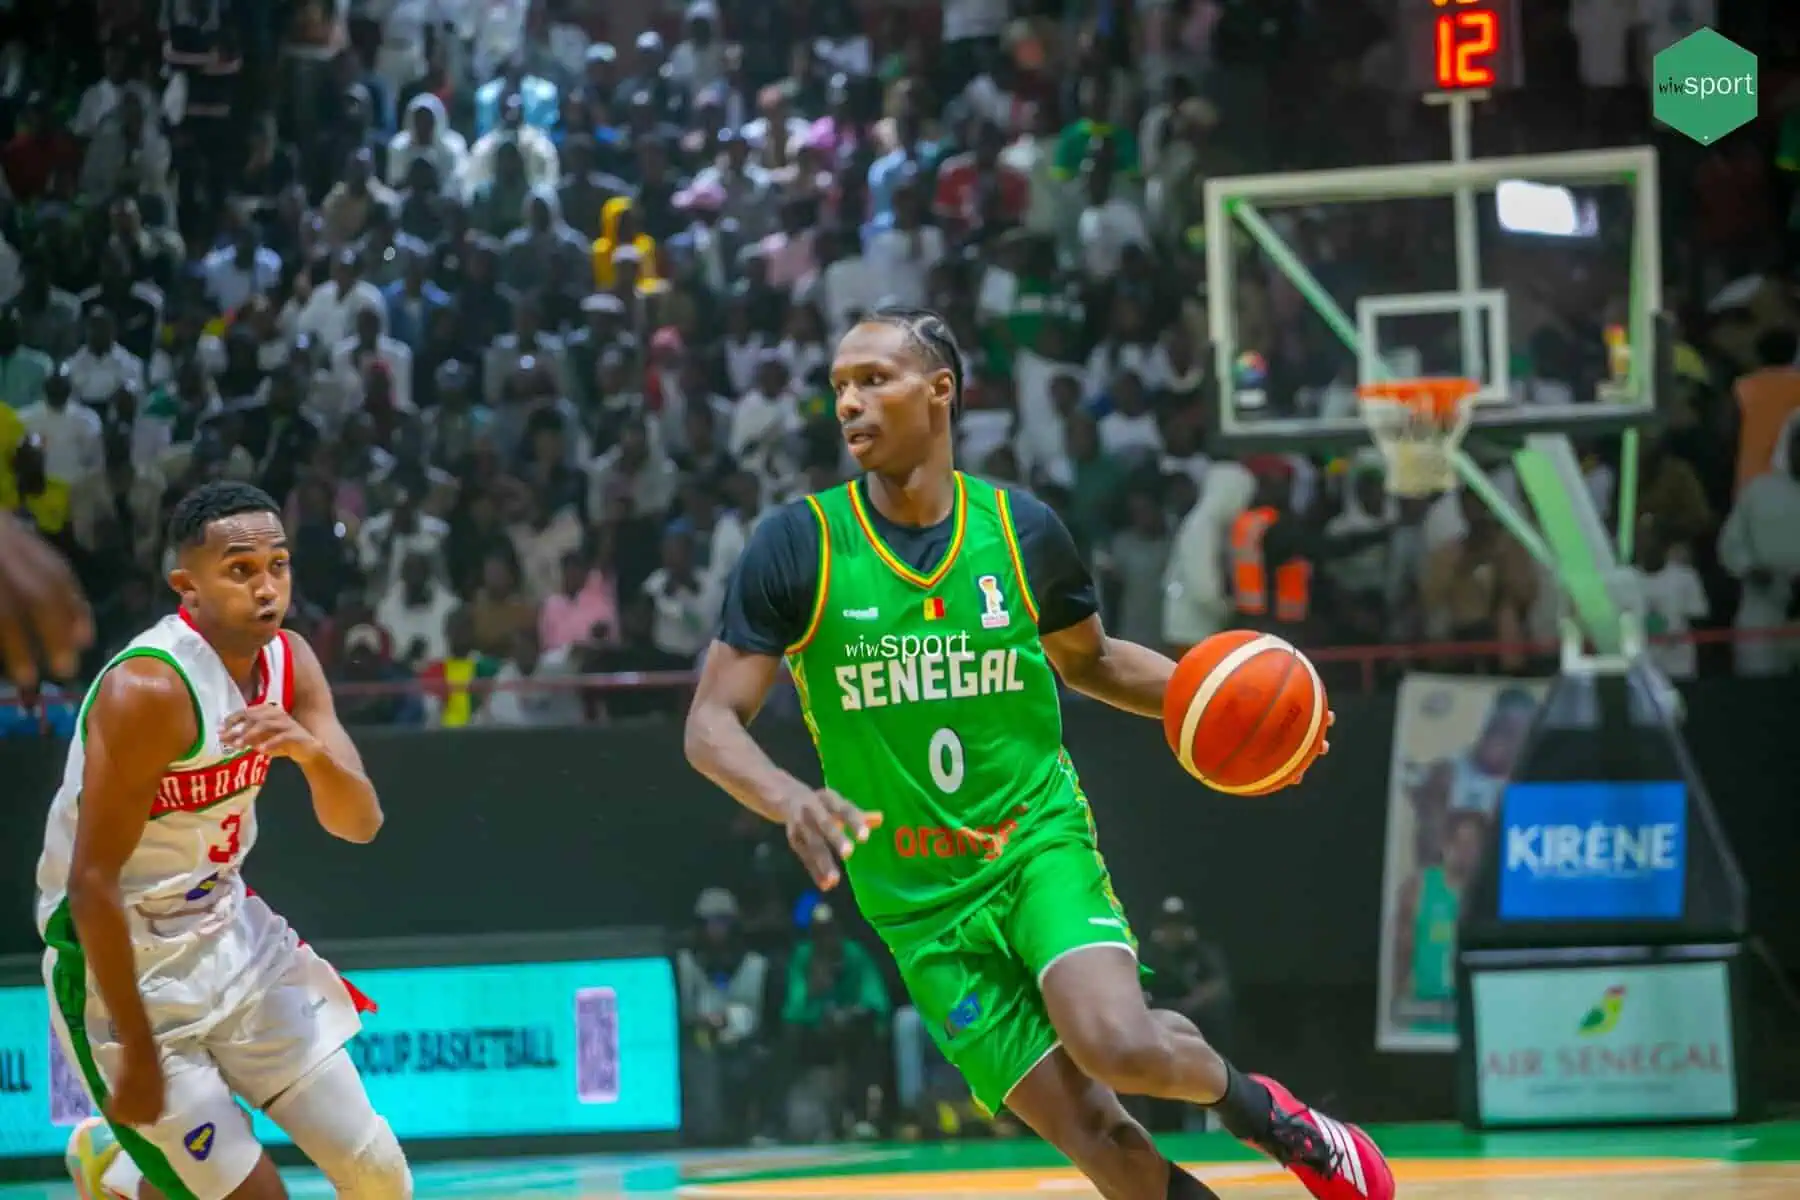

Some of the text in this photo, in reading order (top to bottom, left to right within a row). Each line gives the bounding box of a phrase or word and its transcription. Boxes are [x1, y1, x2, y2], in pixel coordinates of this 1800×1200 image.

[1435, 10, 1498, 87] 12
[835, 648, 1024, 711] SENEGAL
[928, 727, 964, 794] 0
[209, 814, 241, 863] 3
